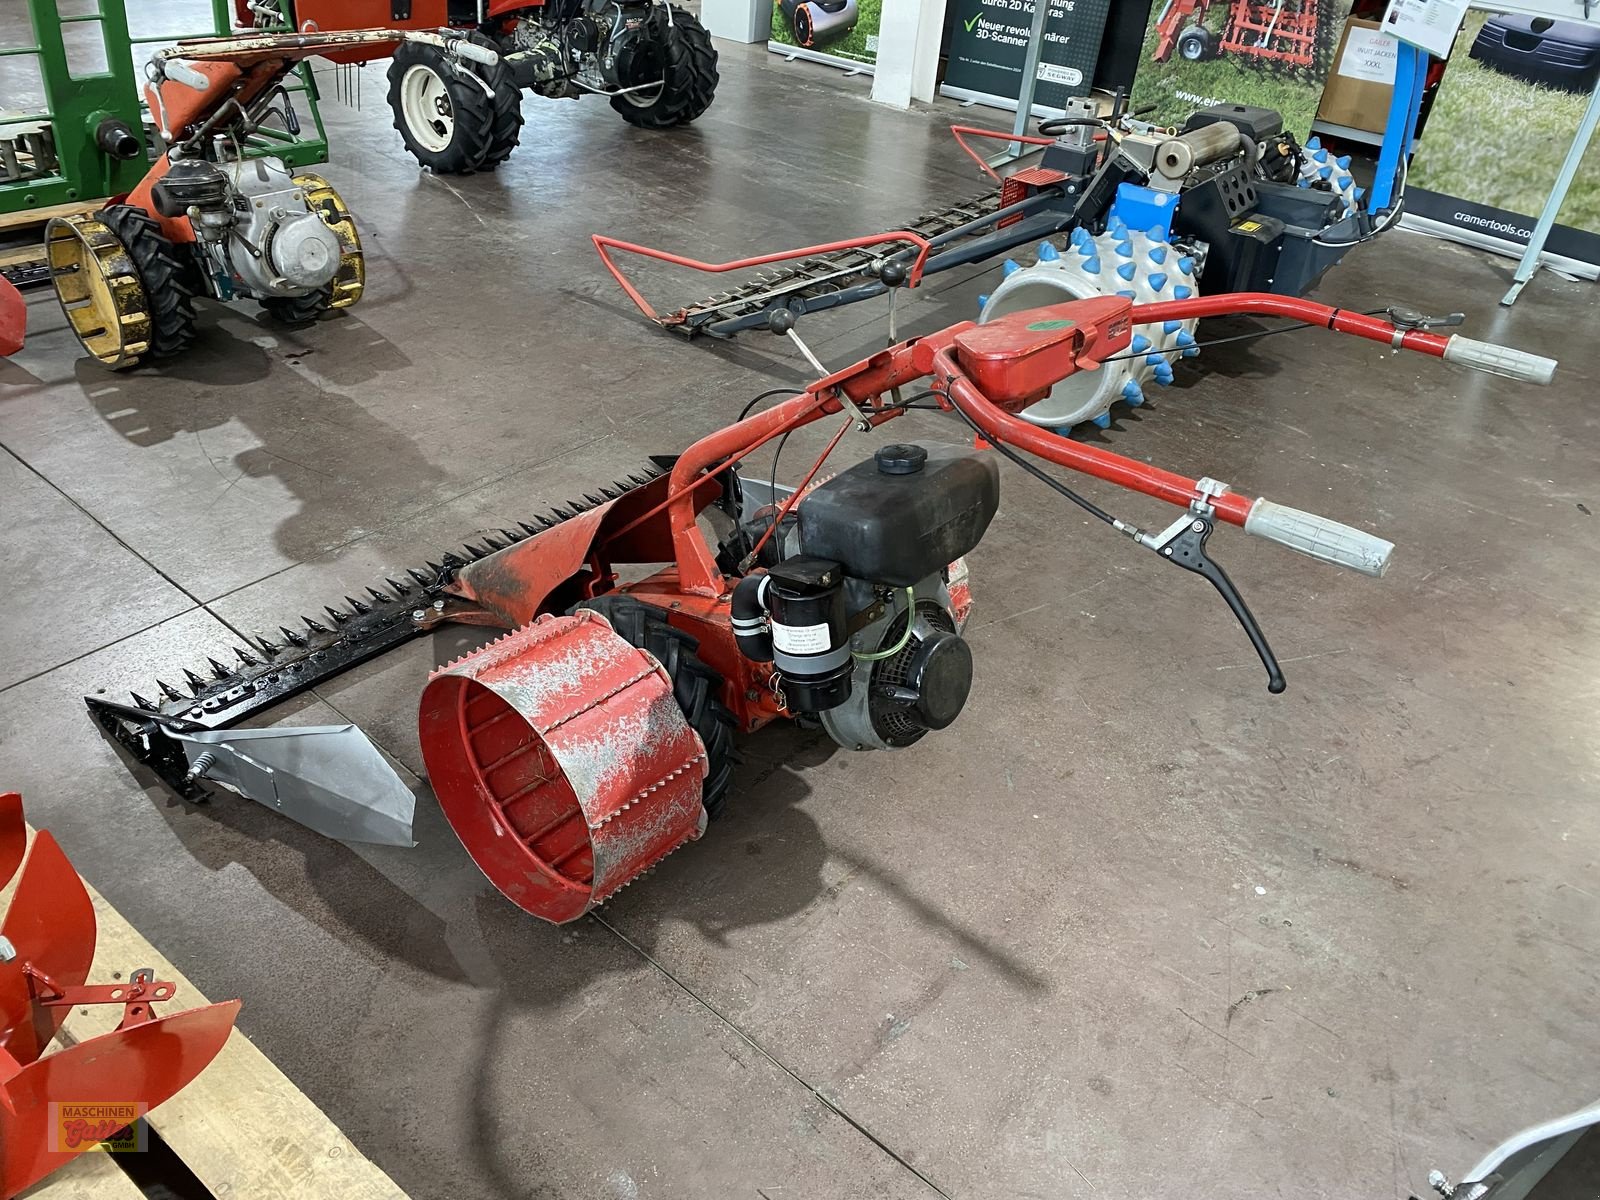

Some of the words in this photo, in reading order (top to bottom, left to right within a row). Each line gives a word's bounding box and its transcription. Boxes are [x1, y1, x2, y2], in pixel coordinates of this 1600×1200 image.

[1009, 1, 1022, 10] 2D
[978, 18, 1005, 32] Neuer
[1006, 25, 1070, 44] revolnärer
[976, 29, 1028, 47] 3D-Scanner
[1364, 60, 1382, 69] XXXL
[1047, 72, 1075, 81] SEGWAY
[1175, 90, 1226, 107] www.ein
